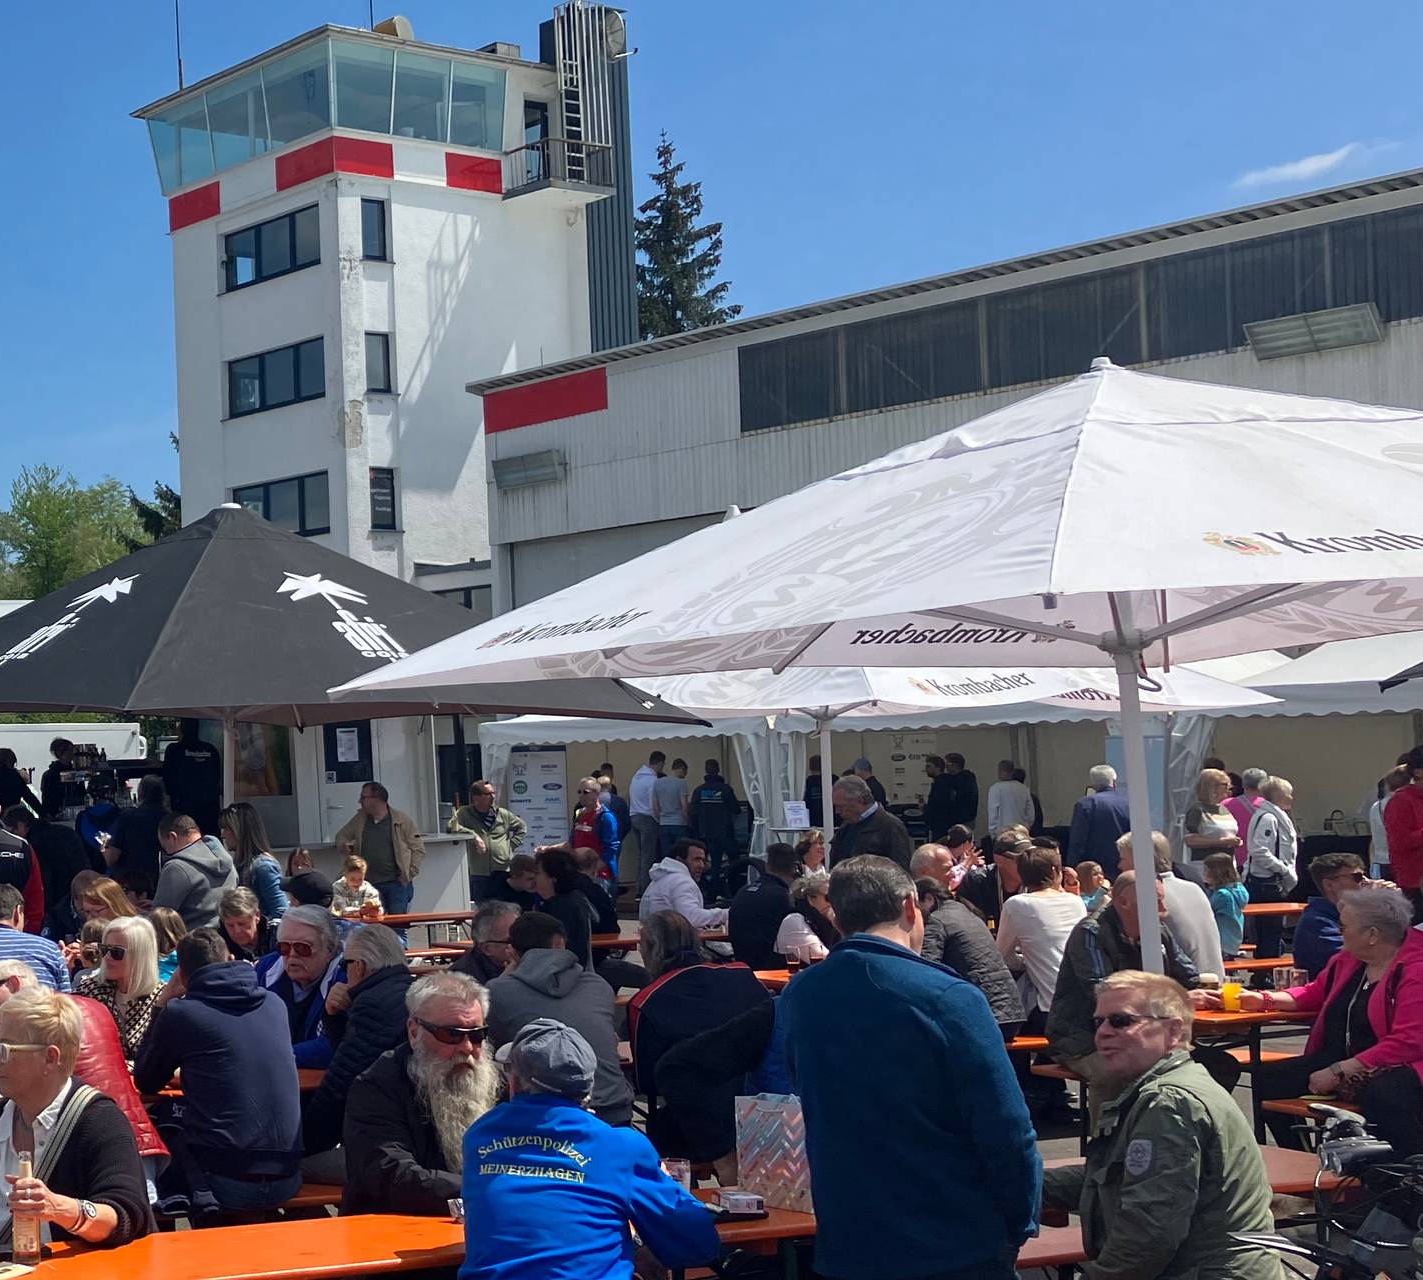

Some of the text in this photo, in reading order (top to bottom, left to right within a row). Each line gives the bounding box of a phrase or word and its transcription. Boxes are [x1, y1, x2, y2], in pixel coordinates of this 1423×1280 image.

[925, 671, 1037, 697] Krombacher
[477, 1135, 592, 1168] Schützenpolizei
[479, 1162, 586, 1184] MEINERZHAGEN
